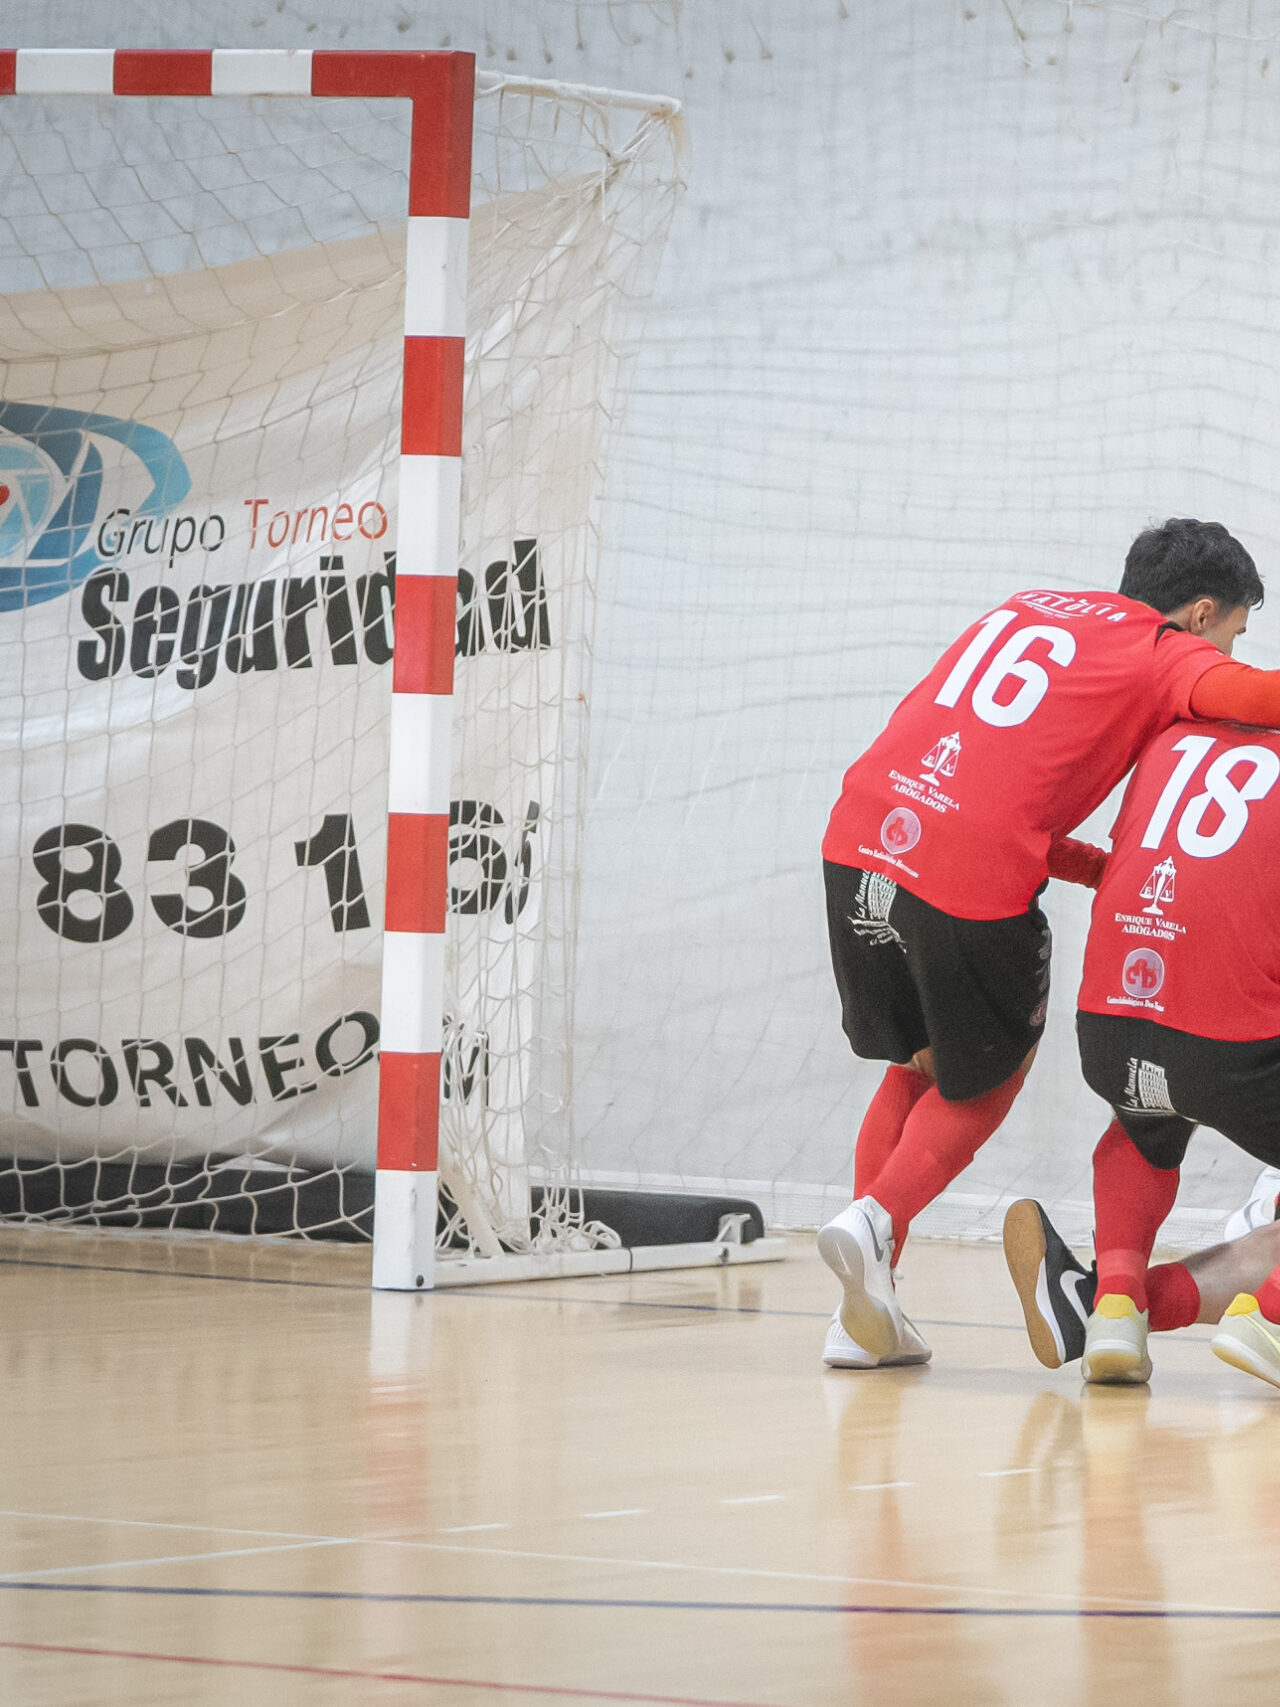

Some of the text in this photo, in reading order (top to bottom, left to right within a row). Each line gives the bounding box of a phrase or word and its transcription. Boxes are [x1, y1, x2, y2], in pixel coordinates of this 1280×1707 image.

[97, 498, 388, 568] Grupo Torneo
[76, 538, 552, 690] Seguridad
[934, 608, 1077, 728] 16
[891, 783, 947, 814] ABOGADOS
[855, 868, 870, 909] Manuel
[1115, 912, 1153, 926] ENRIQUE
[1122, 924, 1176, 942] ABOGADOS
